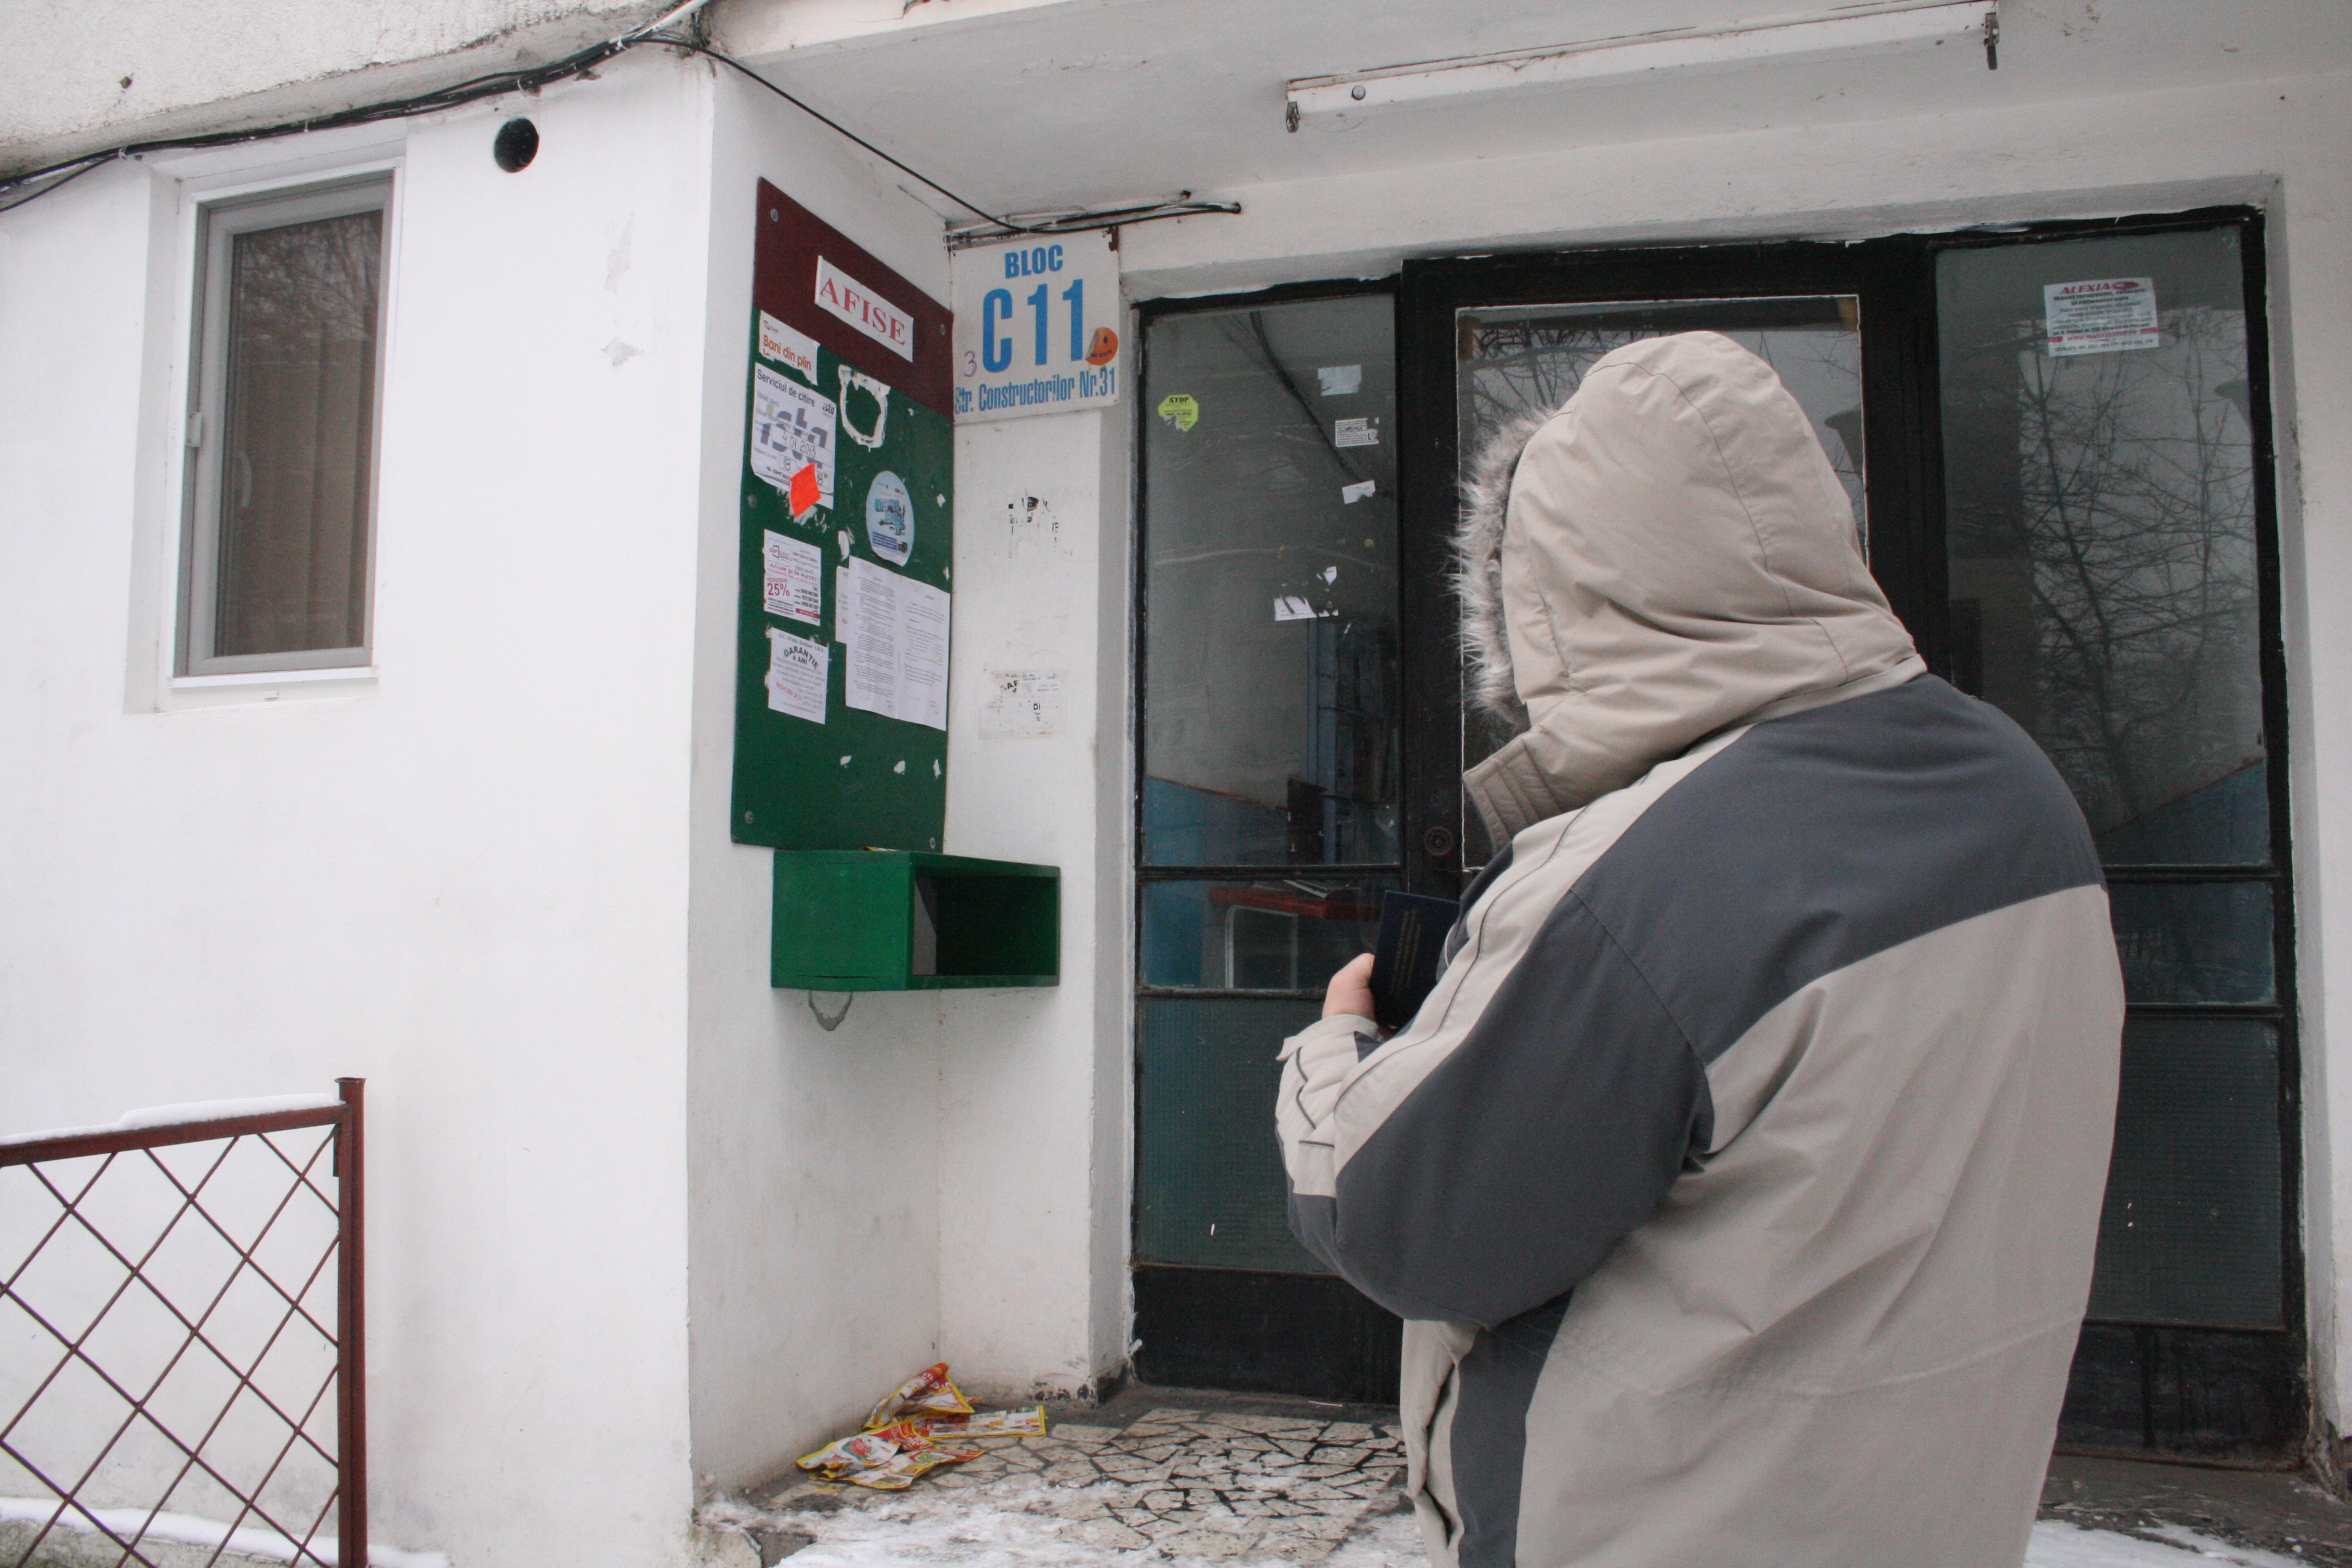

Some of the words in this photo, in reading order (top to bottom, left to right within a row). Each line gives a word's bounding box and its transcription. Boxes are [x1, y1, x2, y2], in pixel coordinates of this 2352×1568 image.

[1005, 244, 1063, 279] BLOC
[2060, 283, 2111, 294] ALEXIA
[820, 277, 906, 346] AFISE
[982, 278, 1083, 373] C11
[763, 334, 781, 354] Bani
[783, 346, 795, 362] din
[797, 355, 811, 371] plin
[964, 350, 978, 377] 3
[757, 369, 787, 393] Serviciul
[788, 386, 797, 397] de
[798, 392, 815, 407] citire
[979, 374, 1075, 411] Constructorilor
[1080, 367, 1116, 398] Nr.31
[767, 583, 791, 596] 25%
[784, 645, 820, 670] GARANTIE
